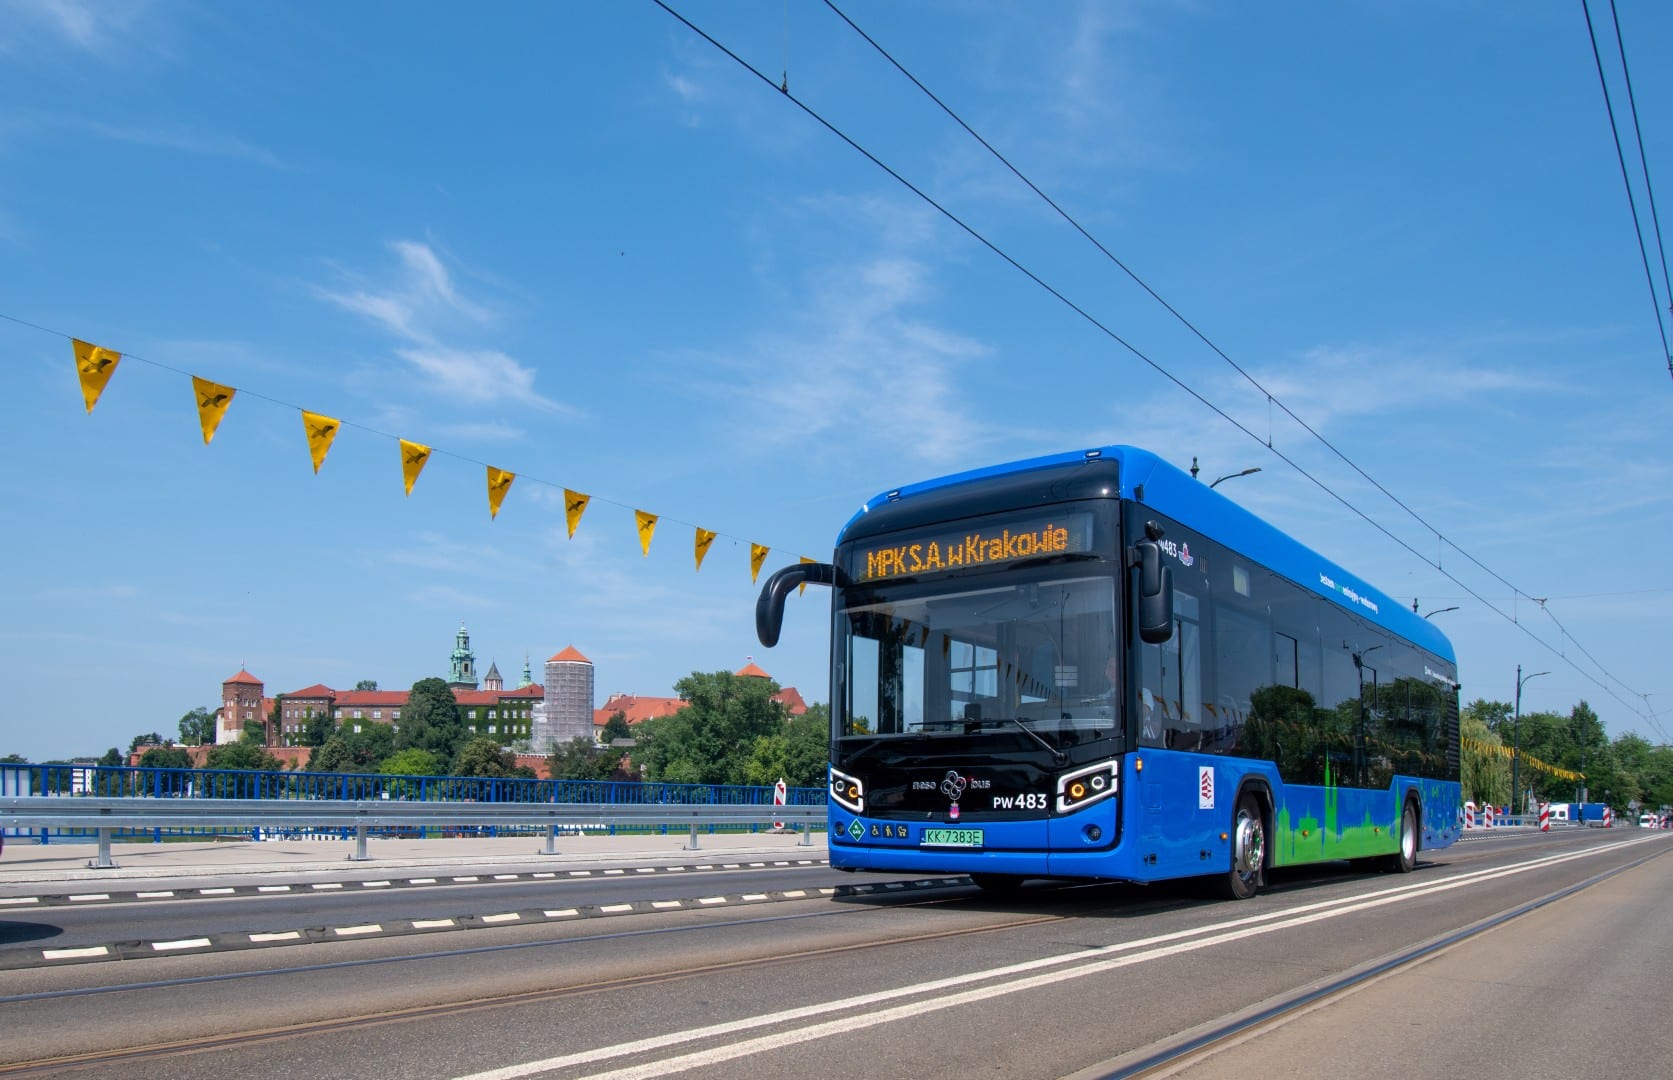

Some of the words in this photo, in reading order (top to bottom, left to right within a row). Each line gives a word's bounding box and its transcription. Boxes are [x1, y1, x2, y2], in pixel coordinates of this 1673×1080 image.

[867, 546, 907, 578] MPK
[909, 541, 945, 573] S.A.
[948, 543, 963, 566] w
[965, 523, 1068, 564] Krakowie
[971, 778, 991, 789] bus
[927, 830, 941, 843] KK
[945, 830, 981, 844] 7383E
